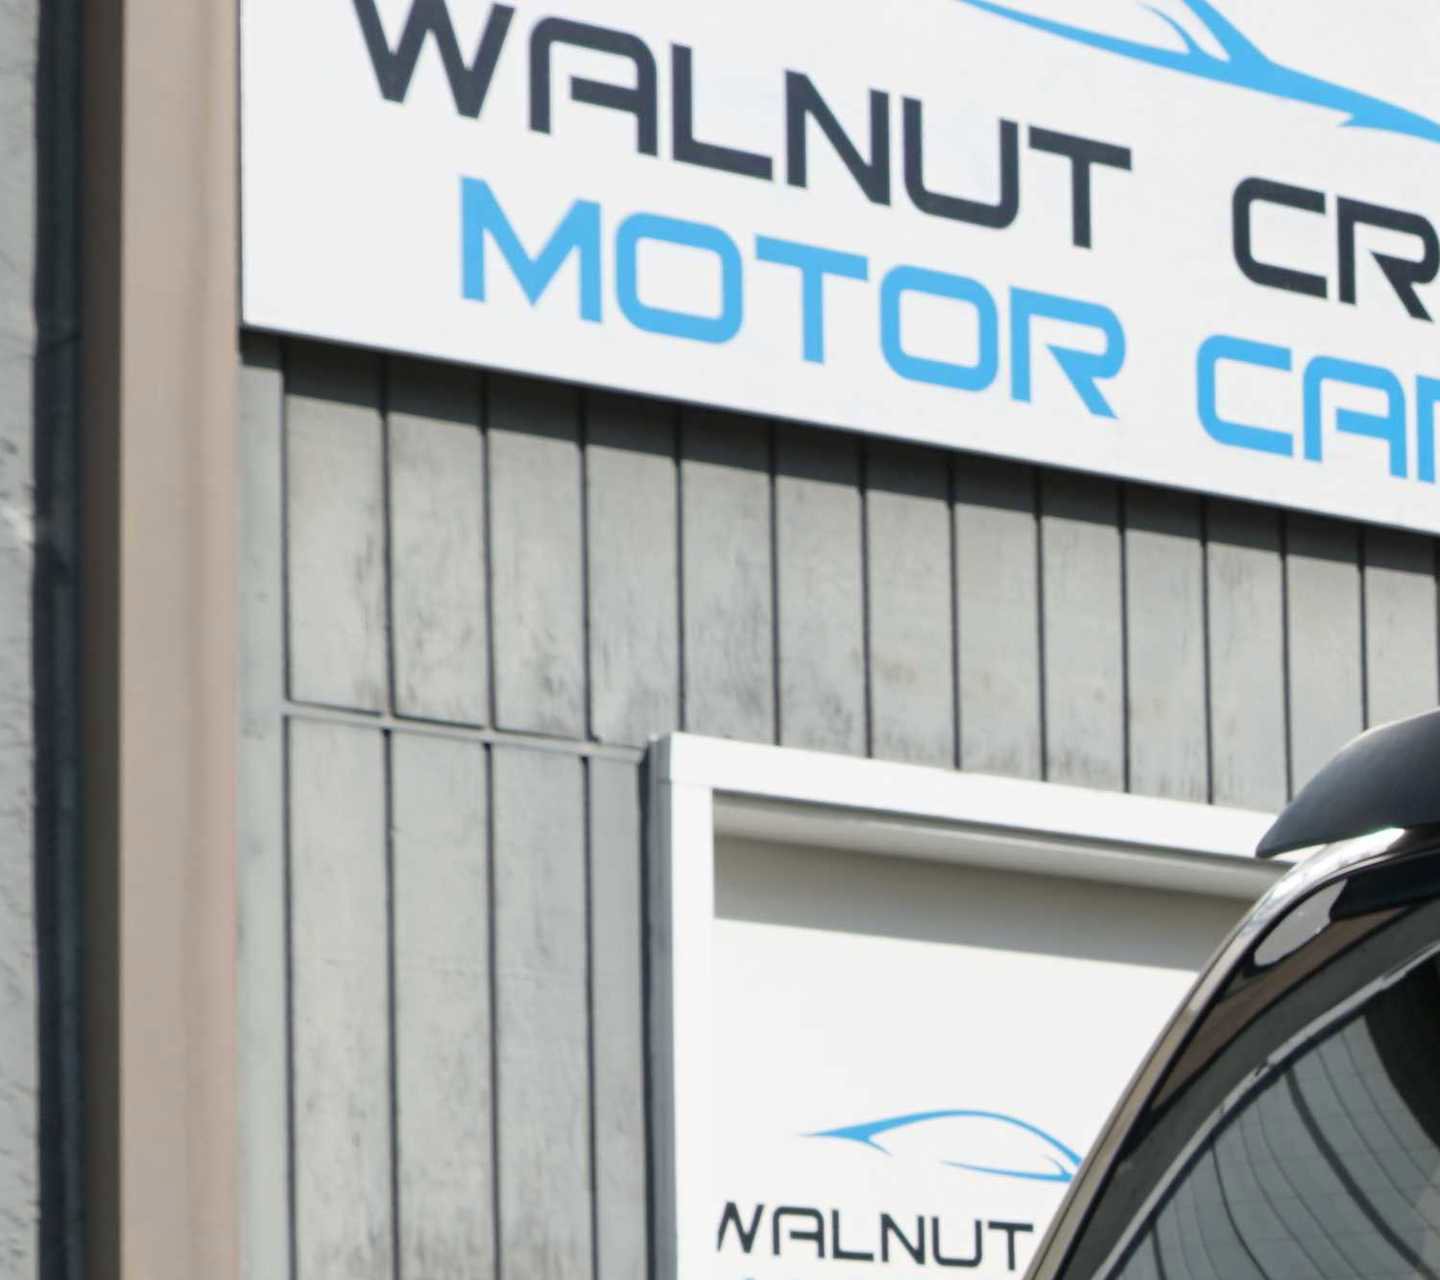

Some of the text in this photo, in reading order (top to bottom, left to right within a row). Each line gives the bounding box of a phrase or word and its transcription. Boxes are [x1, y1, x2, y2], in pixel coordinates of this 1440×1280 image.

[352, 0, 1132, 249] WALNUT
[459, 173, 1127, 421] MOTOR
[716, 1200, 1034, 1271] WALNUT
